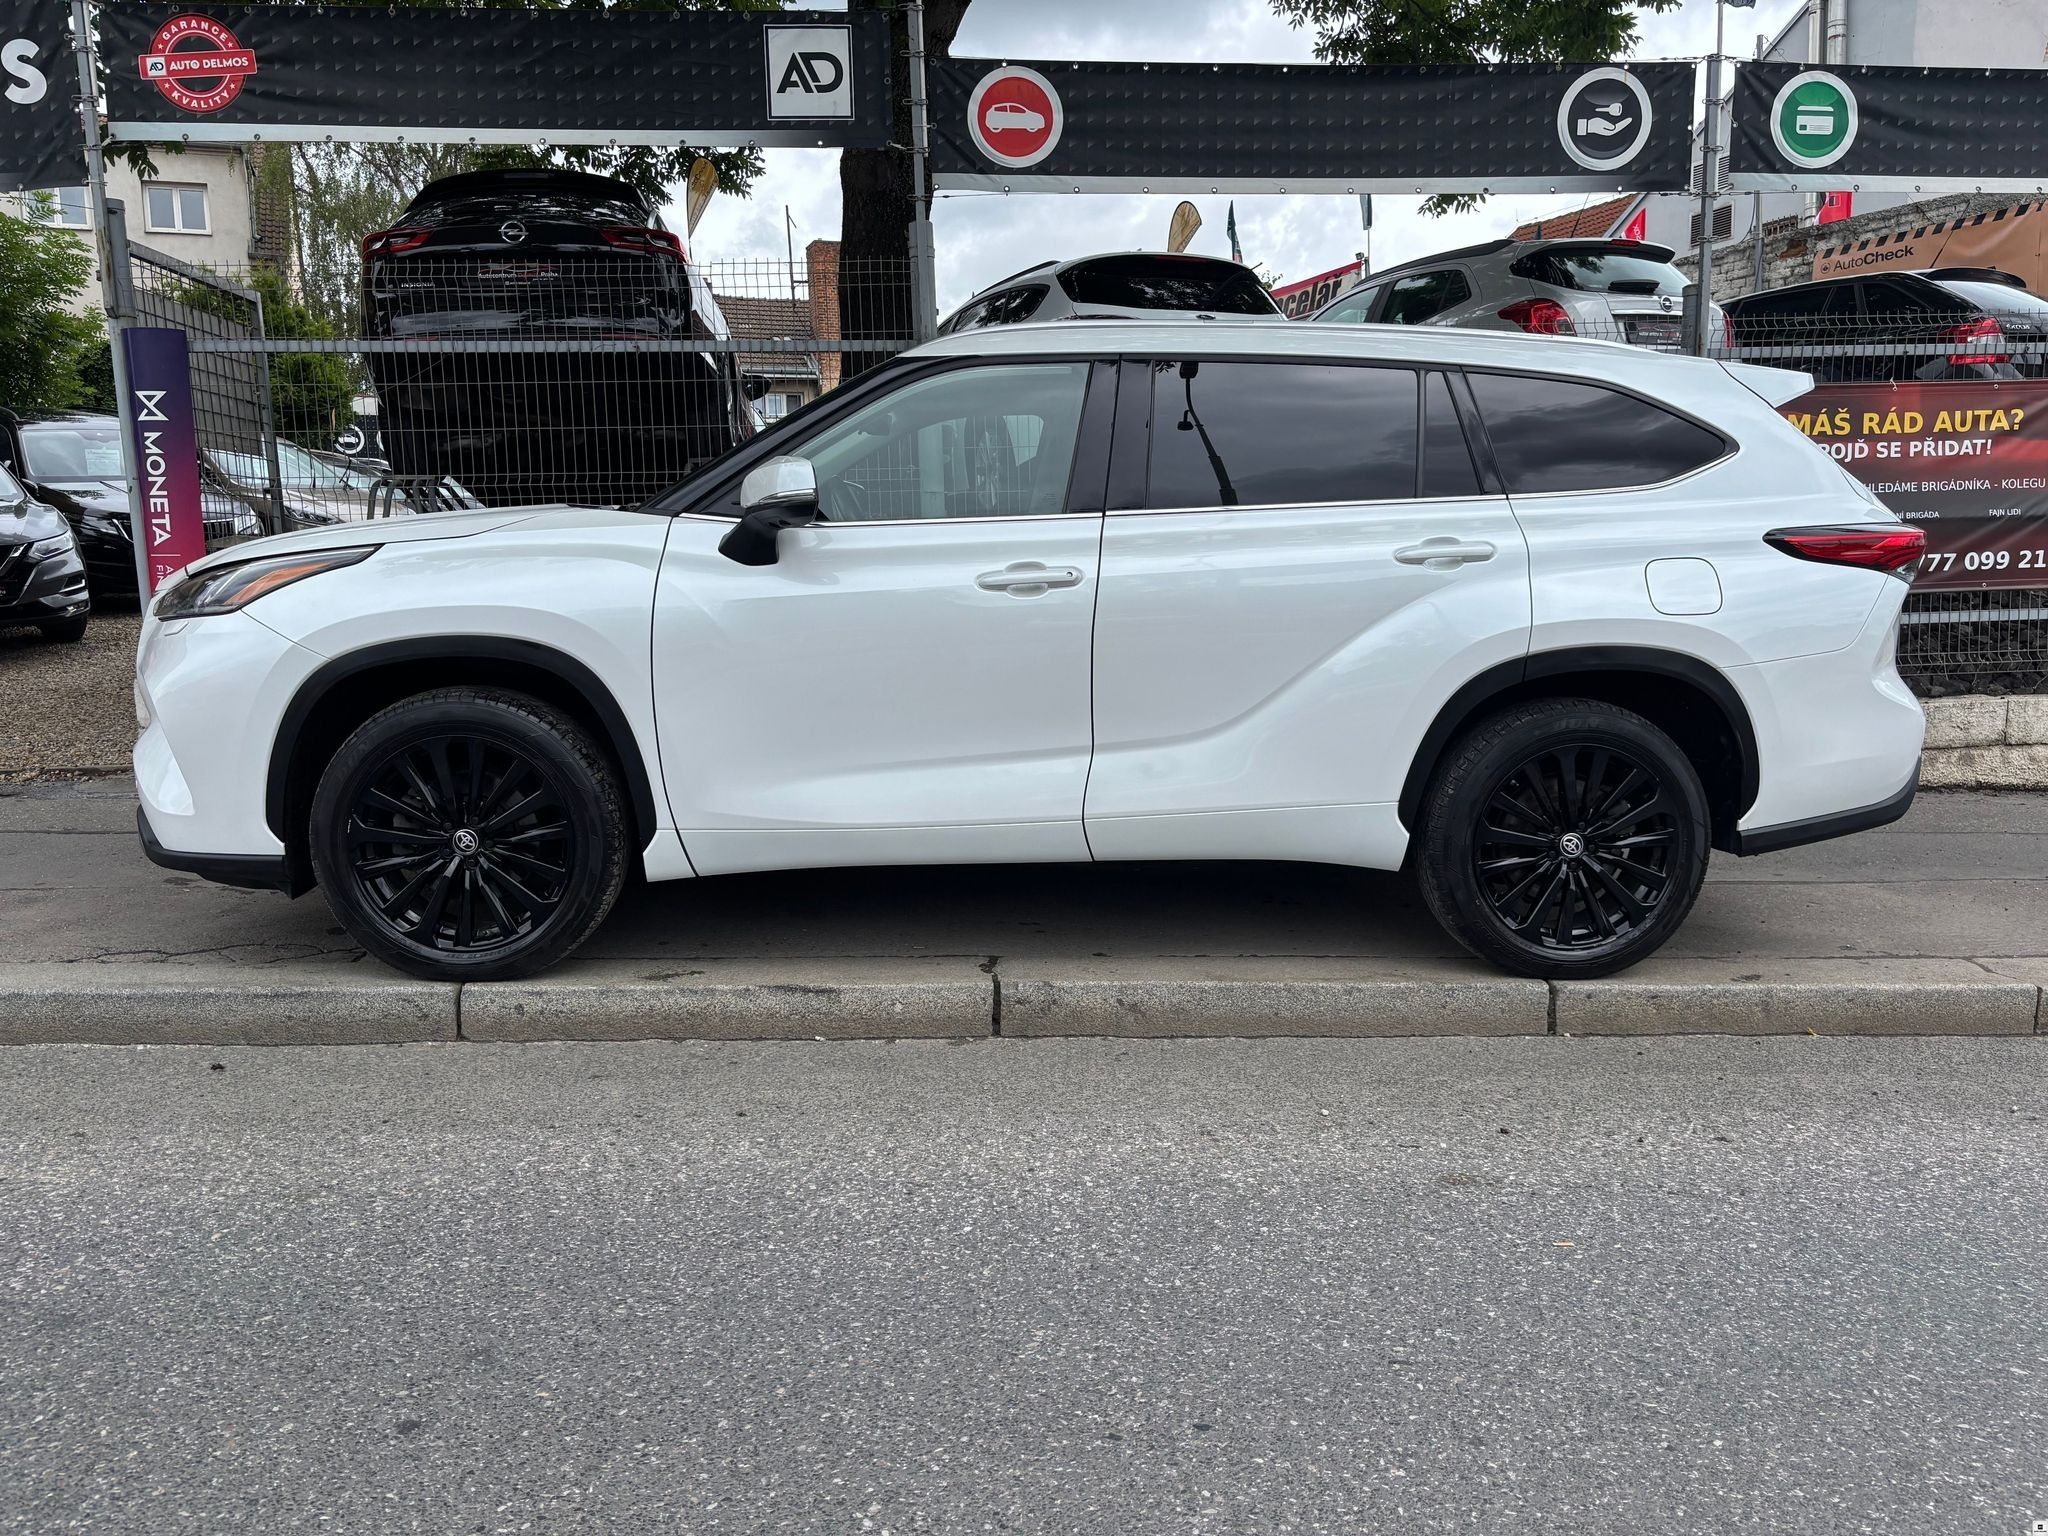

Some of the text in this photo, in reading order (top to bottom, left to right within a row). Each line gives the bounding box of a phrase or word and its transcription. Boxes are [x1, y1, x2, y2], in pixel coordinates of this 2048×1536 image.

[162, 19, 228, 41] GARANCE
[1, 38, 47, 105] S
[170, 60, 200, 71] AUTO
[203, 57, 249, 69] DELMOS
[776, 51, 844, 93] AD
[171, 90, 230, 108] KVALITY
[1833, 245, 1914, 272] AutoCheck
[1787, 406, 2025, 436] MÁŠ RÁD AUTA?
[1876, 441, 1902, 459] SE
[1909, 437, 1992, 457] PŘIDAT!
[144, 431, 172, 547] MONETA
[1921, 478, 1991, 492] BRIGÁDNÍKA
[2001, 478, 2046, 490] KOLEGU
[1906, 510, 1940, 520] BRIGÁDA
[1988, 508, 2021, 517] FAJN LIDI
[1918, 553, 1957, 572] 77
[1964, 551, 2010, 571] 099
